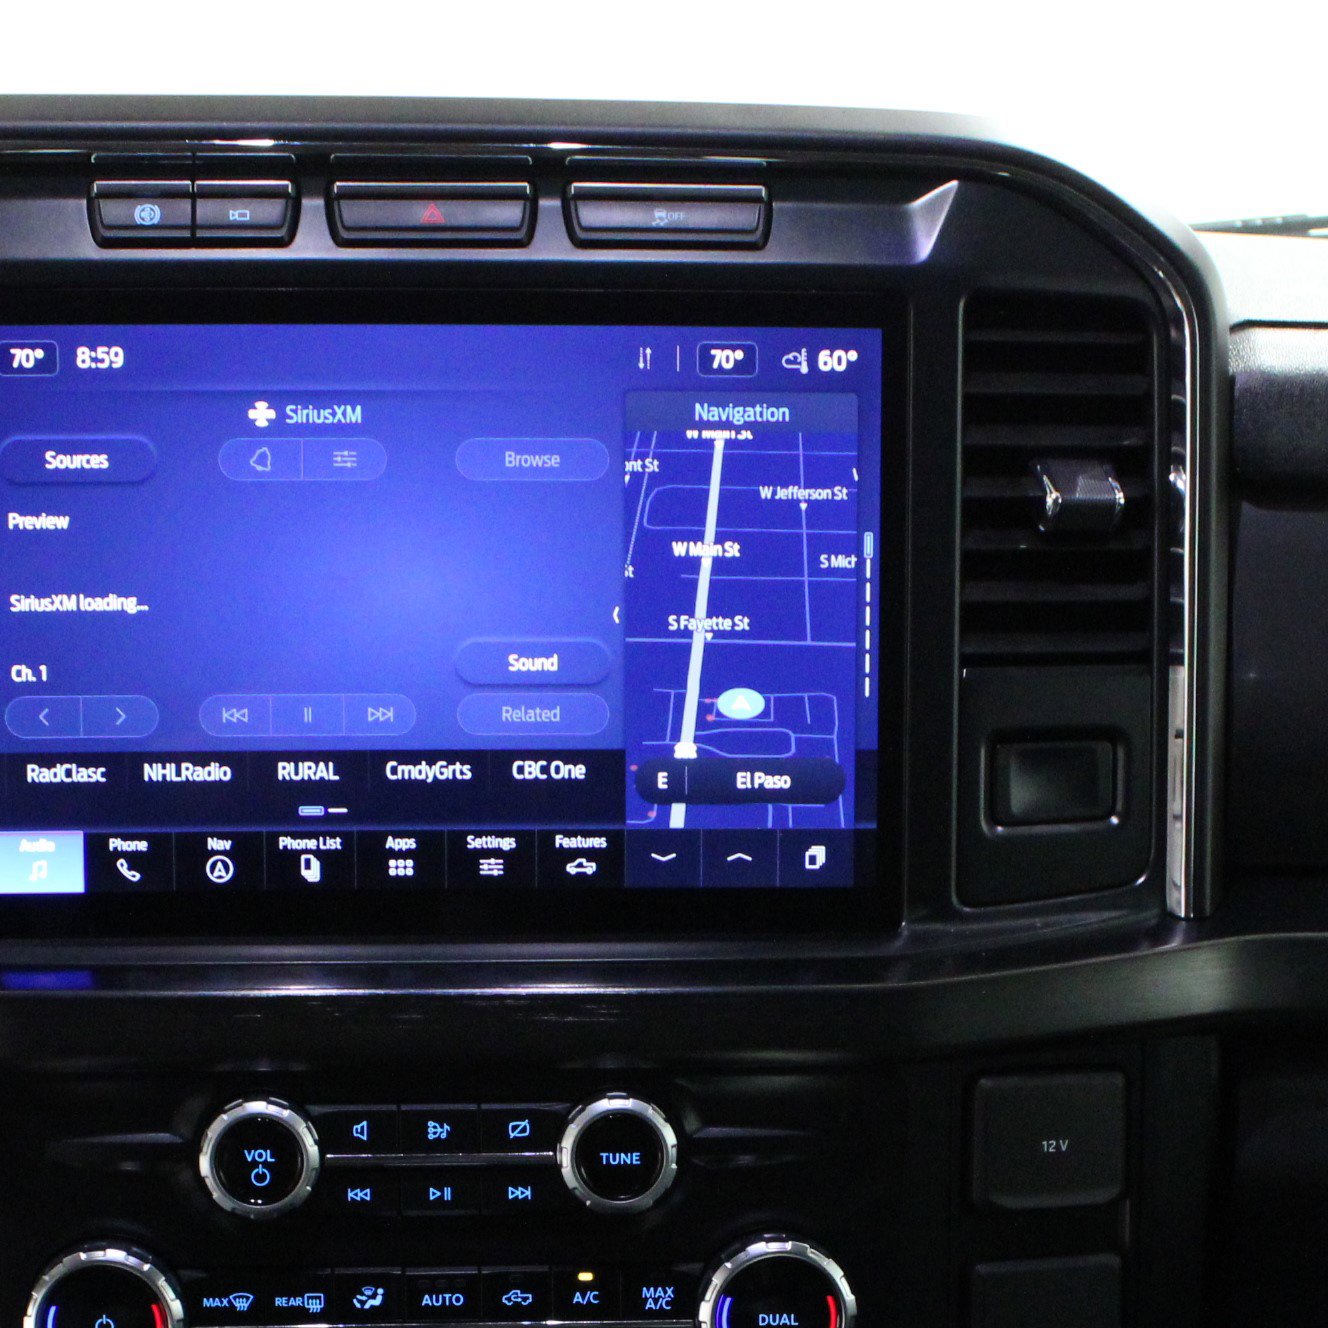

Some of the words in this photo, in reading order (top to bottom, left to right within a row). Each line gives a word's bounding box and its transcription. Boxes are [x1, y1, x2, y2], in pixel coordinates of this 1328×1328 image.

[10, 347, 44, 370] 70°
[75, 346, 124, 370] 8:59
[710, 348, 744, 370] 70°
[817, 349, 859, 372] 60°
[284, 404, 363, 425] SiriusXM
[694, 402, 790, 425] Navigation
[44, 450, 109, 470] Sources
[504, 451, 561, 469] Browse
[644, 458, 660, 472] St
[759, 485, 773, 500] W
[774, 485, 832, 500] Jefferson
[833, 486, 848, 501] St
[7, 512, 70, 531] Preview
[672, 541, 688, 557] W
[689, 541, 723, 557] Main
[723, 541, 741, 557] St
[819, 554, 829, 569] S
[10, 594, 78, 613] SiriusXM
[668, 615, 678, 631] S
[679, 615, 733, 632] Fayette
[733, 615, 751, 631] St
[507, 653, 559, 672] Sound
[10, 664, 38, 682] Ch.
[39, 664, 48, 682] 1
[501, 705, 561, 723] Related
[26, 762, 107, 784] RadClasc
[143, 761, 232, 783] NHLRadio
[277, 760, 340, 781] RURAL
[385, 760, 473, 784] CmdyGrts
[512, 760, 548, 780] CBC
[549, 760, 587, 780] One
[657, 771, 669, 790] E
[736, 771, 752, 790] El
[753, 772, 792, 790] Paso
[109, 837, 148, 853] Phone
[207, 837, 232, 852] Nav
[279, 836, 313, 852] Phone
[314, 836, 342, 852] List
[385, 836, 417, 852] Apps
[466, 835, 517, 852] Settings
[555, 834, 608, 850] Features
[1041, 1139, 1057, 1153] 12
[1058, 1138, 1070, 1152] V
[244, 1148, 276, 1164] VOL
[600, 1151, 642, 1166] TUNE
[421, 1293, 465, 1308] AUTO
[572, 1290, 600, 1305] A/C
[641, 1286, 675, 1299] MAX
[202, 1296, 230, 1308] MAX
[274, 1296, 304, 1308] REAR
[644, 1297, 673, 1311] A/C
[758, 1312, 799, 1327] DUAL
